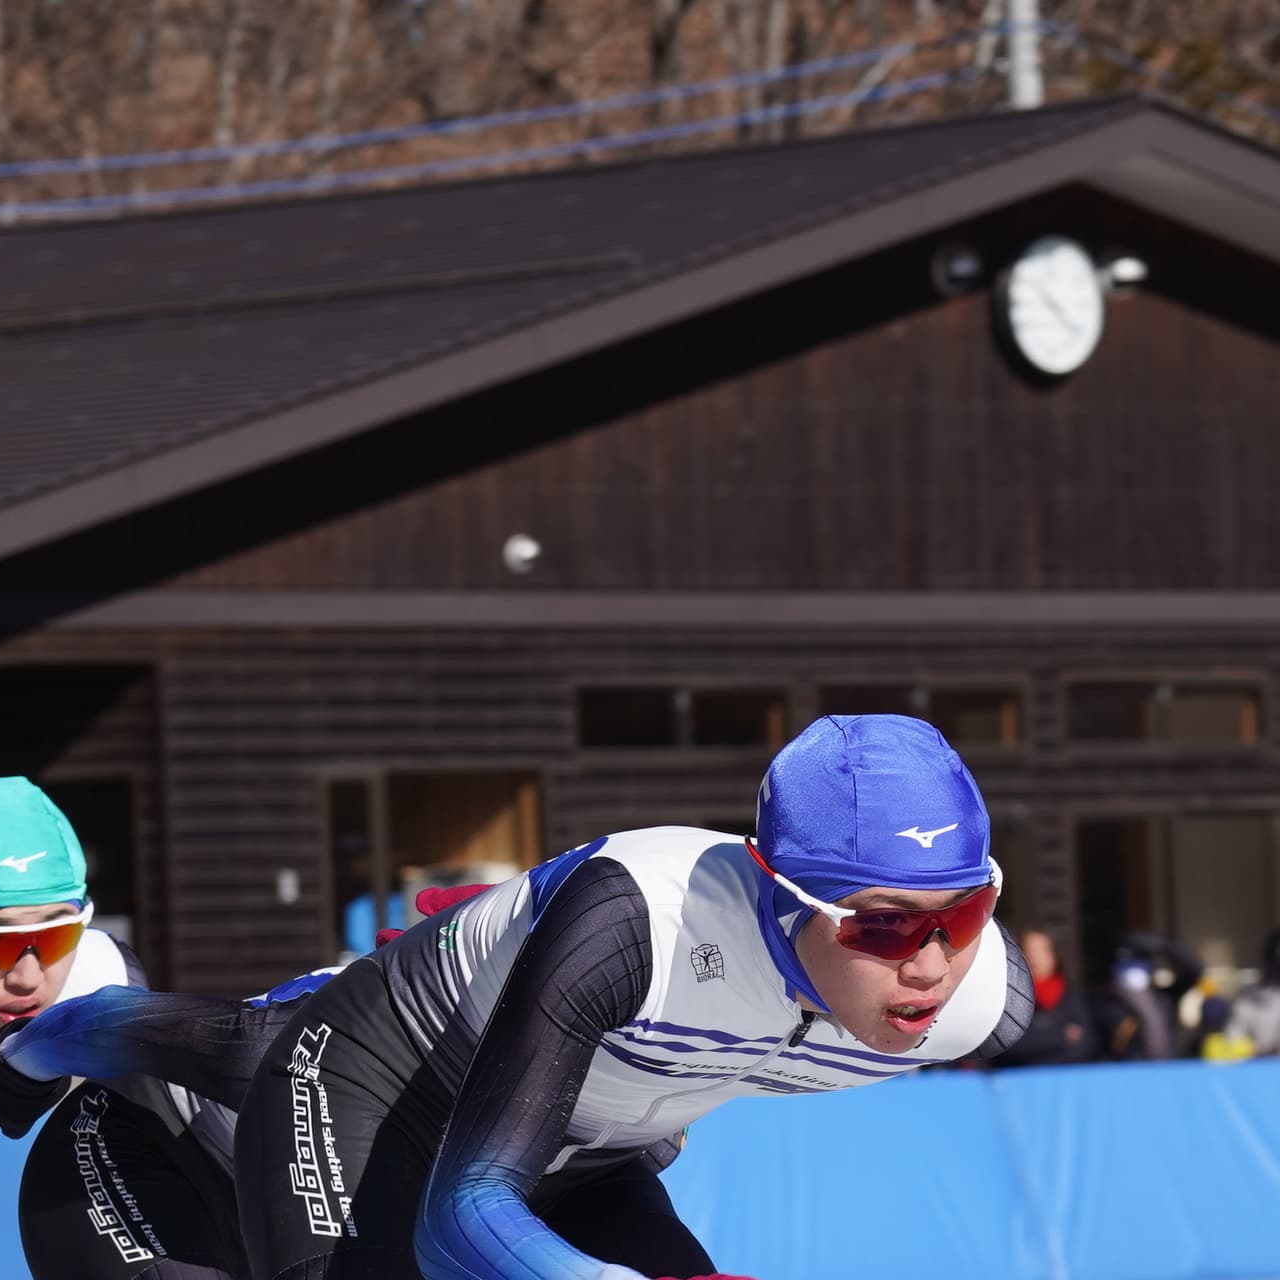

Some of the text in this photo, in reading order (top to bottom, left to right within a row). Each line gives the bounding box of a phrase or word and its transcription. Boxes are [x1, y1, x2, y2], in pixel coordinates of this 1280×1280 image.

[322, 1126, 346, 1193] skating
[339, 1196, 359, 1238] team
[140, 1223, 168, 1256] team
